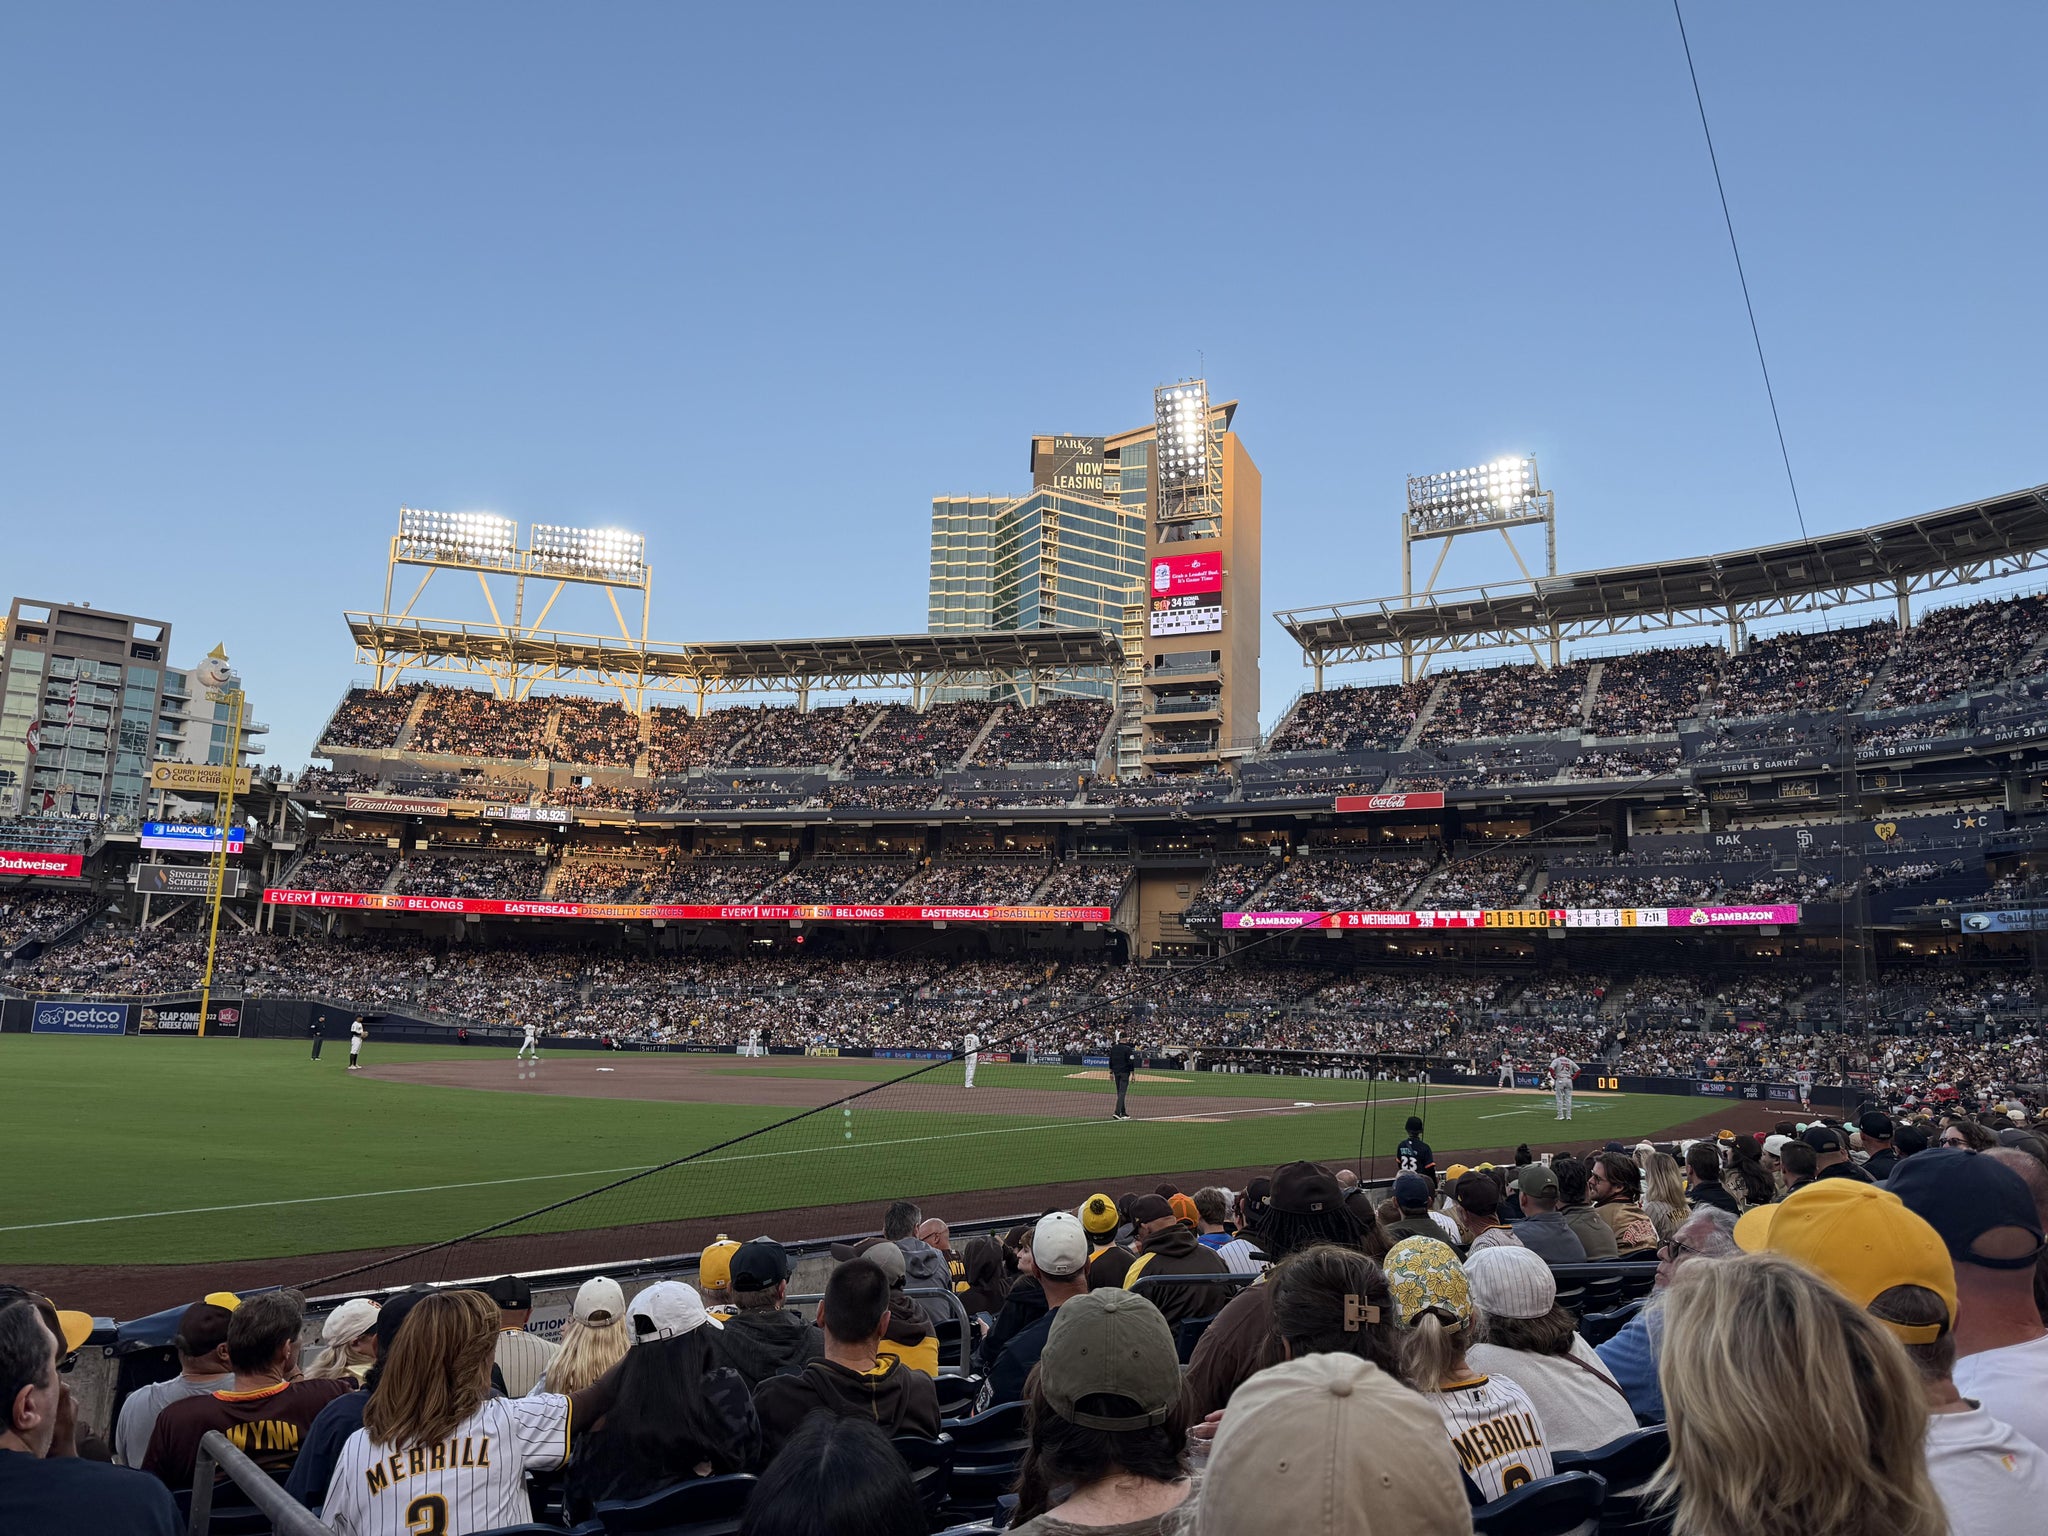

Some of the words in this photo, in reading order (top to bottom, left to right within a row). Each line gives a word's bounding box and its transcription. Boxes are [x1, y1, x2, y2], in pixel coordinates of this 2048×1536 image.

[1055, 439, 1084, 448] PARK
[1082, 446, 1093, 455] 12
[1075, 462, 1103, 475] NOW
[1053, 475, 1103, 490] LEASING
[1171, 598, 1182, 607] 34
[1995, 731, 2020, 742] DAVE
[2023, 727, 2036, 737] 31
[1857, 749, 1880, 759] TONY
[1884, 748, 1896, 756] 19
[1899, 744, 1932, 754] GWYNN
[1721, 763, 1748, 772] STEVE
[1753, 762, 1760, 770] 6
[1765, 759, 1799, 768] GARVEY
[173, 768, 197, 776] CURRY
[197, 769, 222, 777] HOUSE
[197, 776, 246, 786] ICHIBAYA
[349, 798, 403, 812] Tarantino
[404, 805, 446, 814] SAUSAGES
[536, 809, 567, 821] $8,925
[1953, 817, 1961, 829] J
[1978, 816, 1988, 827] C
[166, 825, 207, 836] LANDCARE
[1715, 835, 1742, 846] RAK
[0, 856, 68, 872] Budweiser
[320, 894, 353, 905] WITH
[408, 899, 464, 910] BELONGS
[504, 903, 579, 915] EASTERSEALS
[581, 906, 638, 916] DISABILITY
[639, 908, 684, 916] SERVICES
[762, 907, 789, 917] WITH
[836, 908, 885, 917] BELONGS
[921, 908, 990, 918] EASTERSEALS
[992, 909, 1050, 918] DISABILITY
[1053, 909, 1103, 919] SERVICES
[1255, 917, 1303, 925] SAMBAZON
[1348, 914, 1359, 925] 26
[1362, 913, 1410, 925] WETHERHOLT
[1540, 911, 1547, 926] 0
[1644, 912, 1659, 922] 7:11
[1711, 911, 1773, 921] SAMBAZON
[1418, 918, 1434, 927] .239
[1445, 918, 1450, 927] 7
[1466, 918, 1475, 927] 18
[64, 1007, 120, 1025] petco
[159, 1011, 179, 1021] SLAP
[179, 1012, 201, 1022] SOME
[158, 1021, 182, 1029] CHEESE
[182, 1021, 193, 1030] ON
[192, 1022, 200, 1030] IT
[1083, 1058, 1110, 1066] citycruise
[1560, 1063, 1570, 1073] 75
[1710, 1083, 1726, 1092] SHOP
[1401, 1156, 1418, 1171] 23
[1666, 1207, 1690, 1223] MACHA
[523, 1318, 566, 1333] AUTION
[226, 1419, 298, 1451] WYNN
[1452, 1412, 1542, 1474] MERRILL
[365, 1436, 490, 1497] MERRILL
